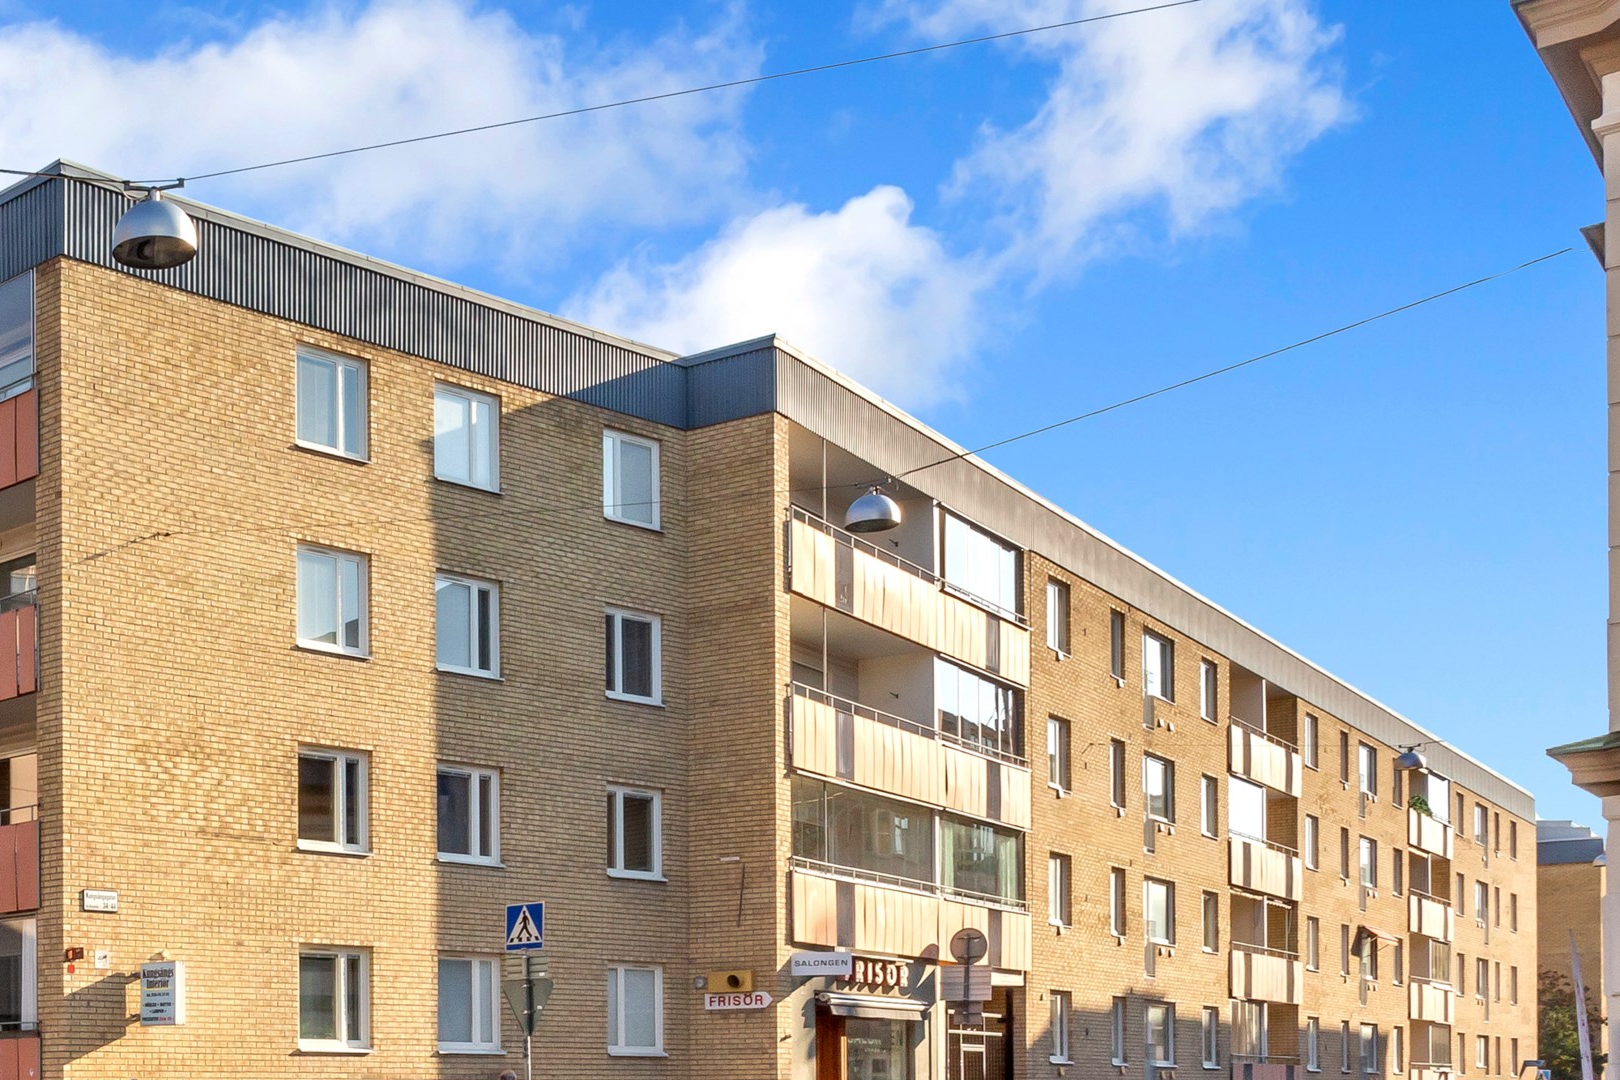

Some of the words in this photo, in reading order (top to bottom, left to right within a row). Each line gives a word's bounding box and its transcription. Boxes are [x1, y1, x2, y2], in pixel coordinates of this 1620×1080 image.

[794, 959, 848, 967] SALONGEN
[143, 968, 173, 979] Kungsängs
[709, 993, 763, 1007] FRISÖR
